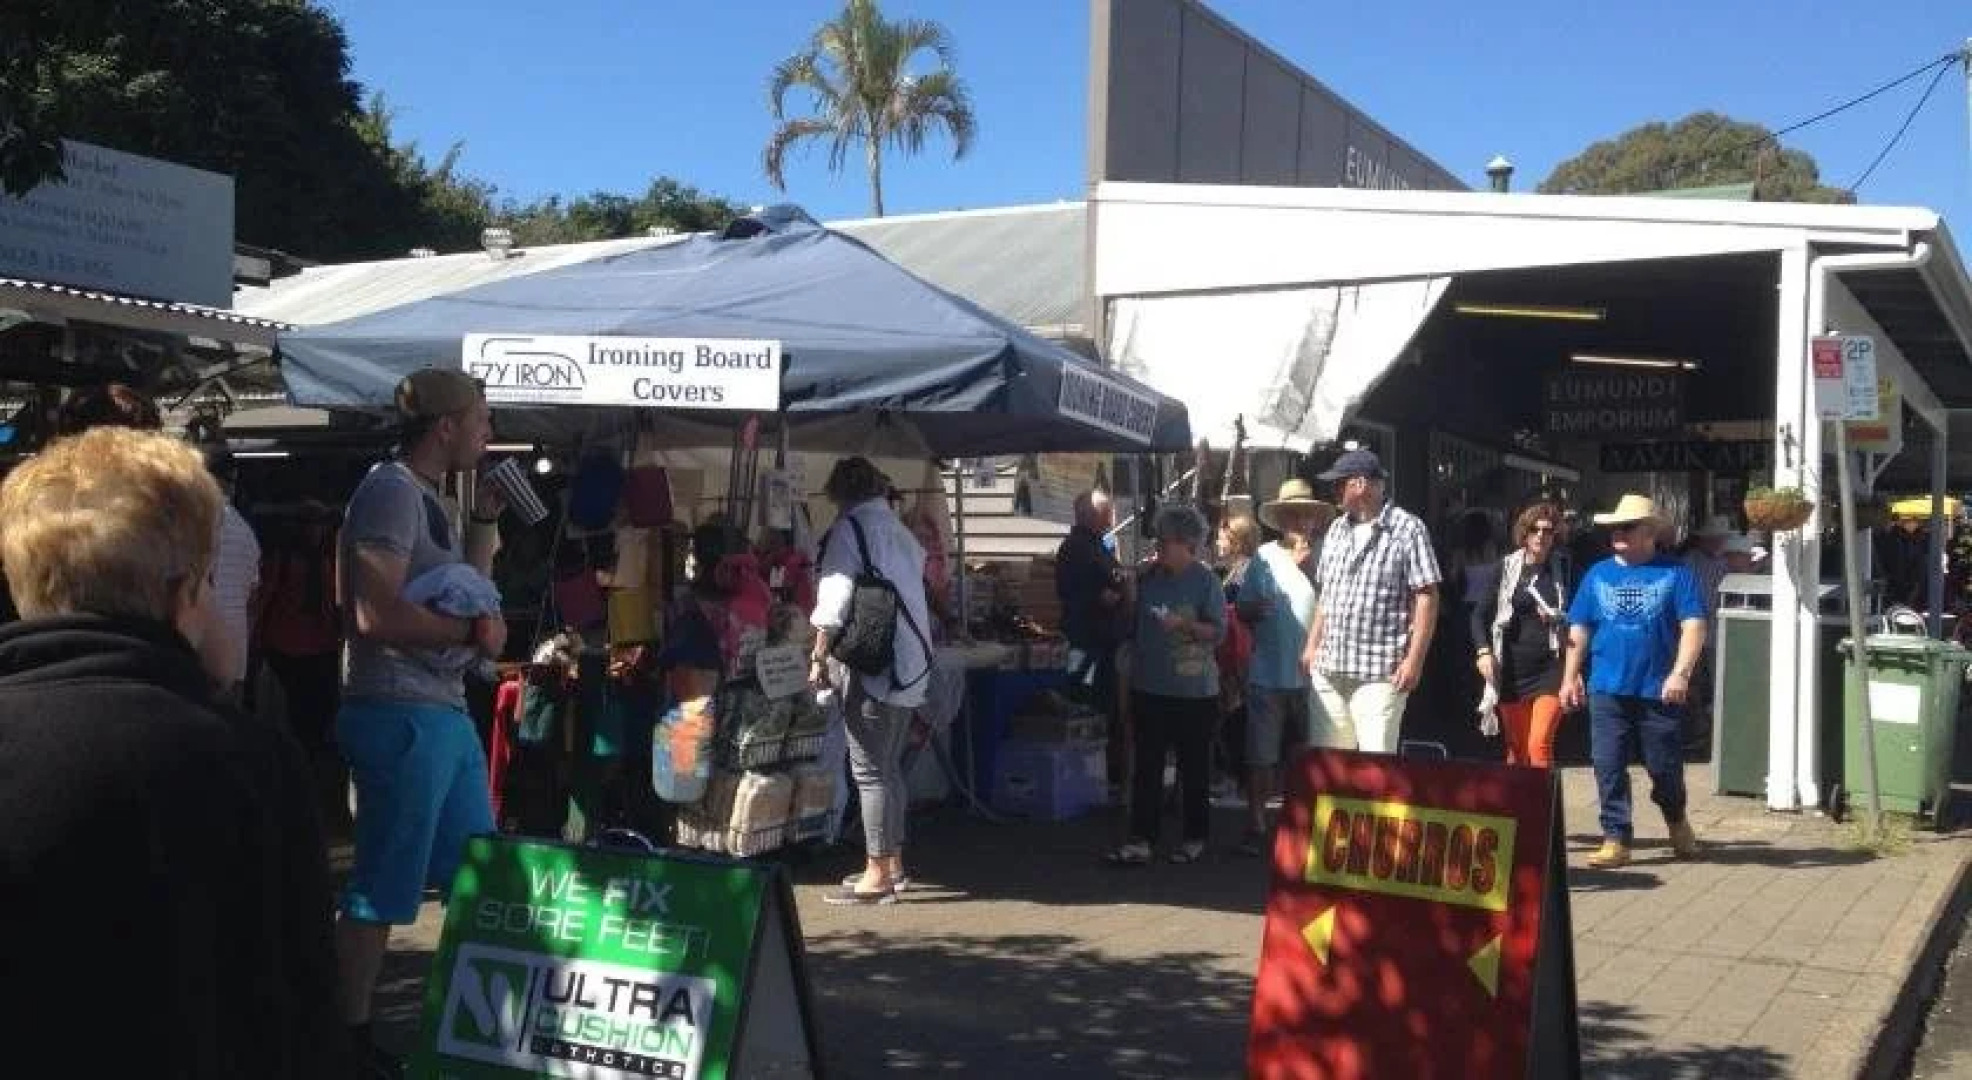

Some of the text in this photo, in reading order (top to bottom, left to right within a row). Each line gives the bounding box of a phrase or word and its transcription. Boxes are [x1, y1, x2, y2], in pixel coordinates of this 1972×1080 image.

[588, 342, 771, 373] Ironing Board
[1847, 341, 1871, 360] 2P
[516, 363, 571, 386] IRON
[633, 377, 723, 402] Covers
[1548, 375, 1677, 401] EUMUNDI
[1548, 407, 1678, 433] EMPORIUM
[1323, 808, 1499, 894] CHURROS
[532, 866, 674, 916] WE FIX
[476, 901, 586, 941] SORE
[545, 967, 695, 1026] ULTRA
[533, 1007, 693, 1058] CUSHION
